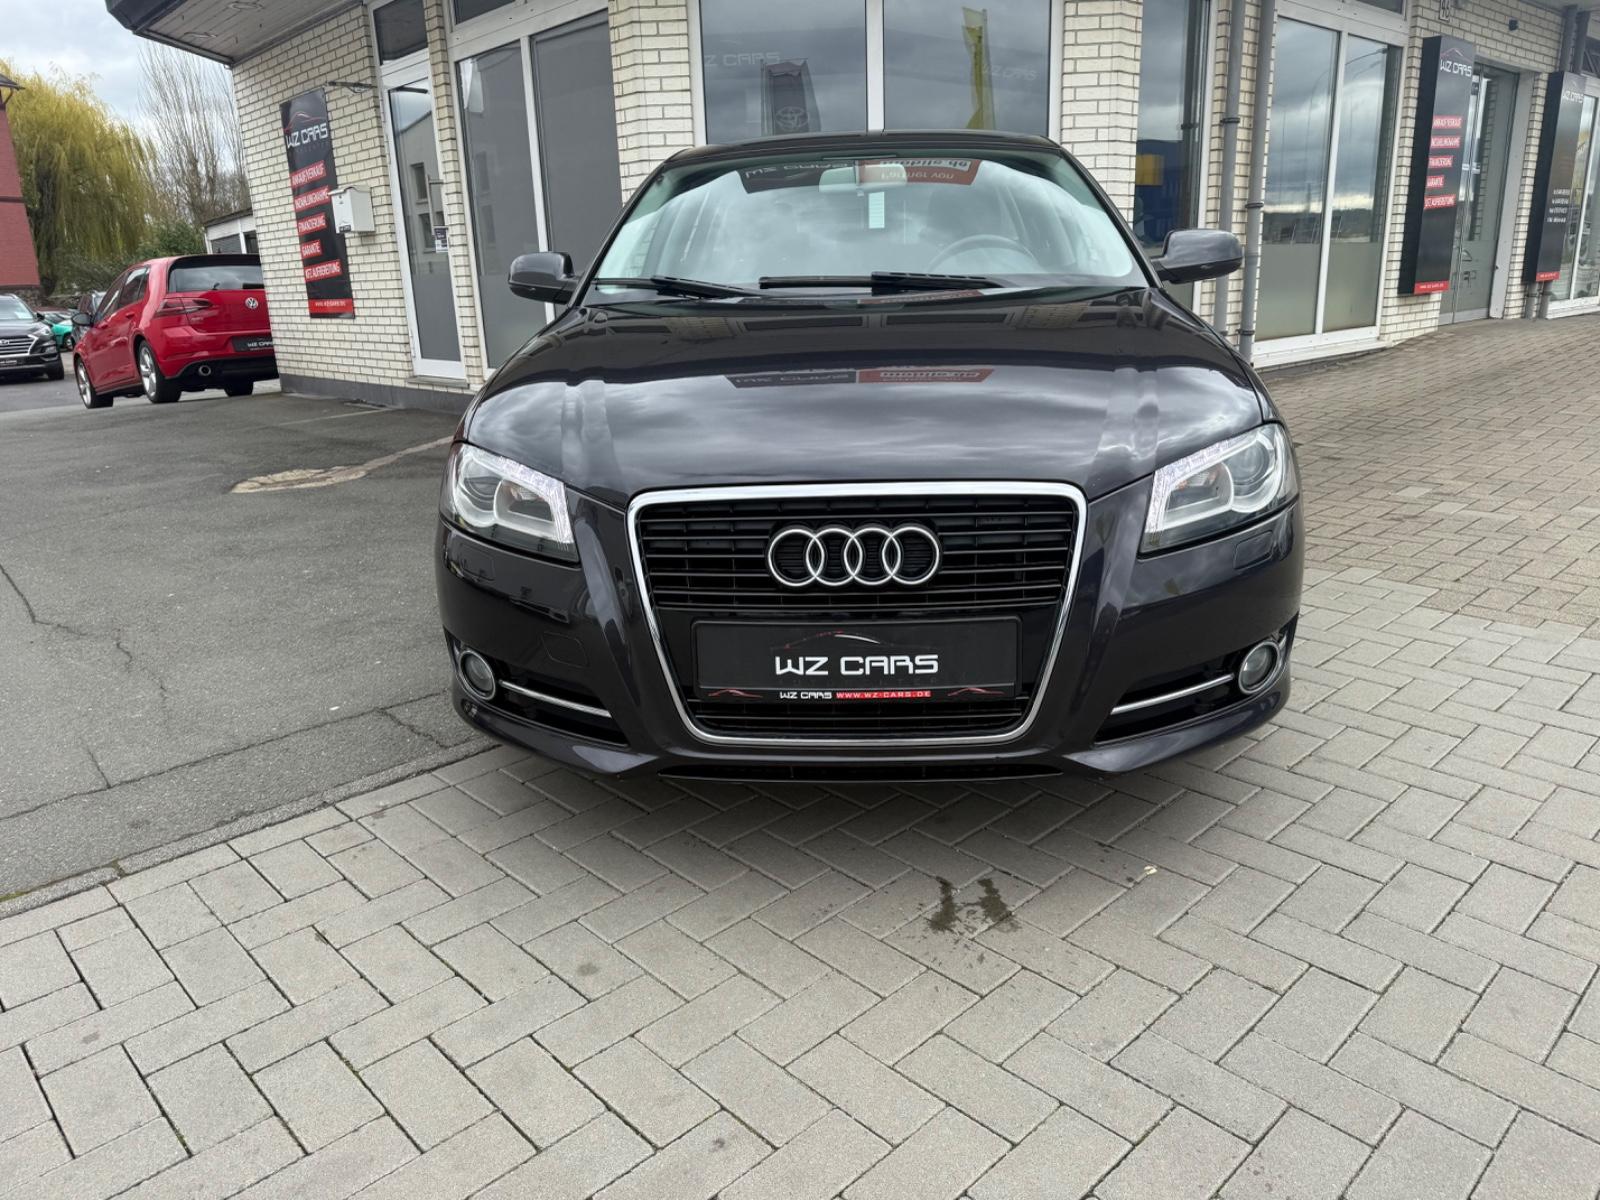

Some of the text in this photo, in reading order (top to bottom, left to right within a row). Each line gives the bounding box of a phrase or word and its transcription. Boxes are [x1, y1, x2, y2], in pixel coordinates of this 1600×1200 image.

[1440, 59, 1452, 73] WZ
[286, 131, 300, 149] WZ
[301, 122, 328, 144] CARS
[775, 654, 939, 676] WZ CARS
[779, 691, 798, 699] WZ
[800, 691, 832, 699] CARS
